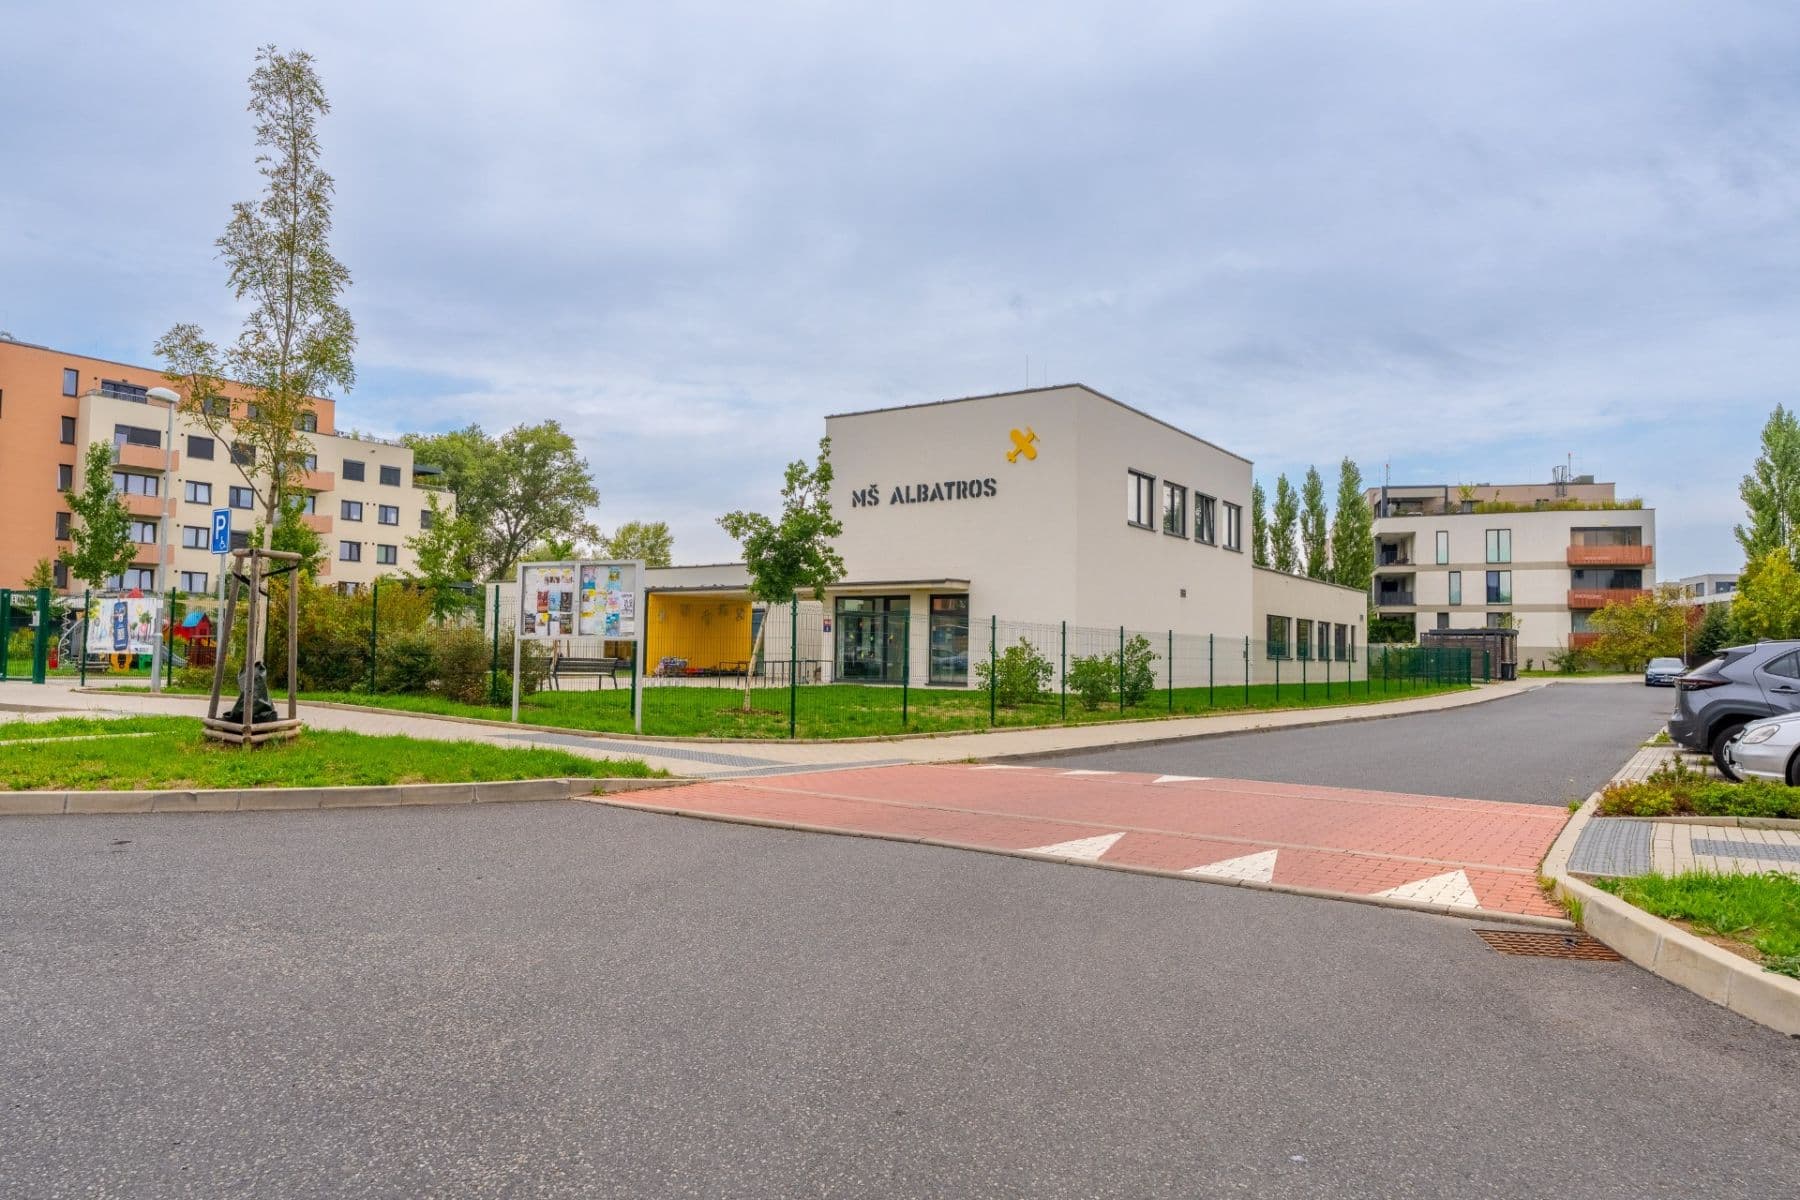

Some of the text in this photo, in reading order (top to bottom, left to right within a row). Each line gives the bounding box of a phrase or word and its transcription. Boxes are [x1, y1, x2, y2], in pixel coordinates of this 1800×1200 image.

[852, 477, 998, 508] MŠ ALBATROS
[215, 514, 227, 540] P
